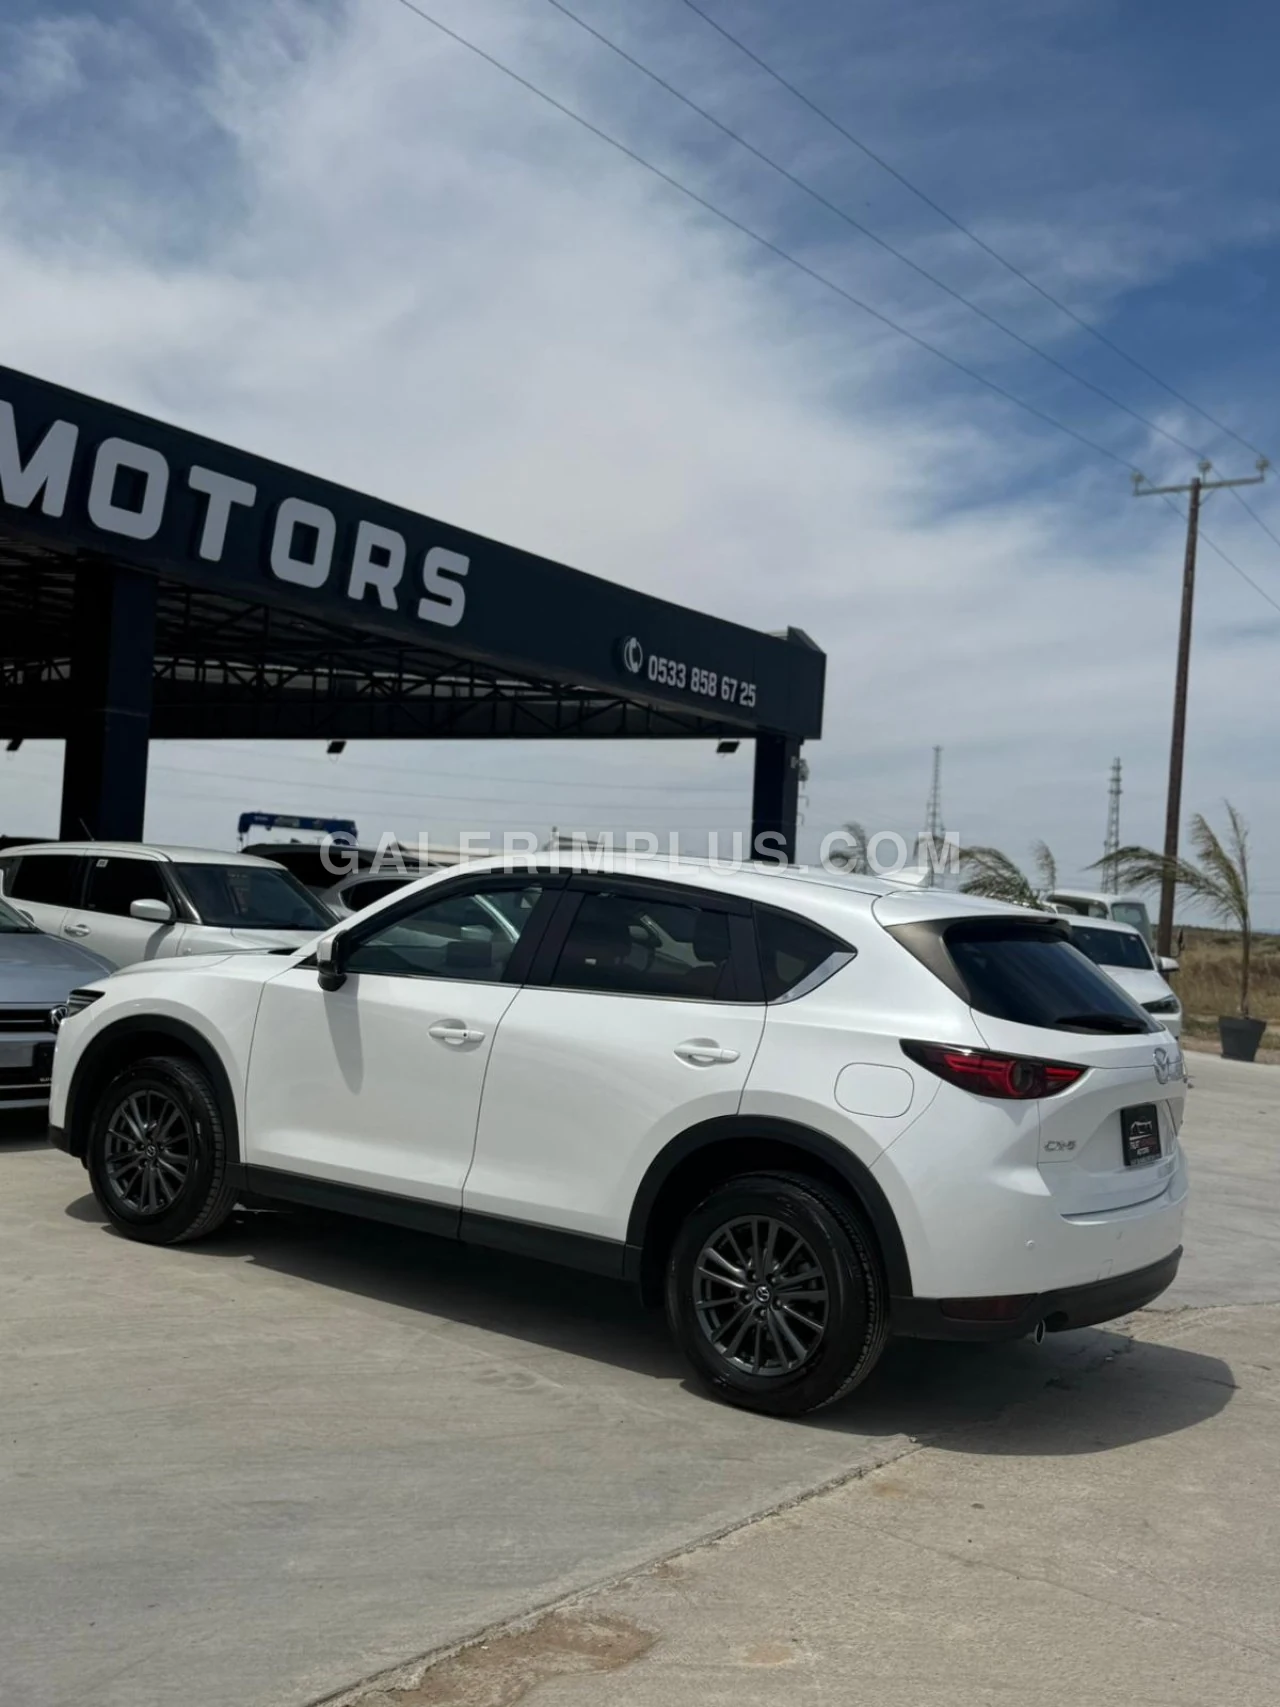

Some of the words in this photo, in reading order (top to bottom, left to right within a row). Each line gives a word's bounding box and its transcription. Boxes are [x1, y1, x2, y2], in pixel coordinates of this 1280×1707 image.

[0, 400, 470, 627] MOTORS
[648, 655, 686, 688] 0533
[691, 667, 717, 697] 858
[721, 676, 738, 702] 67
[739, 682, 757, 708] 25
